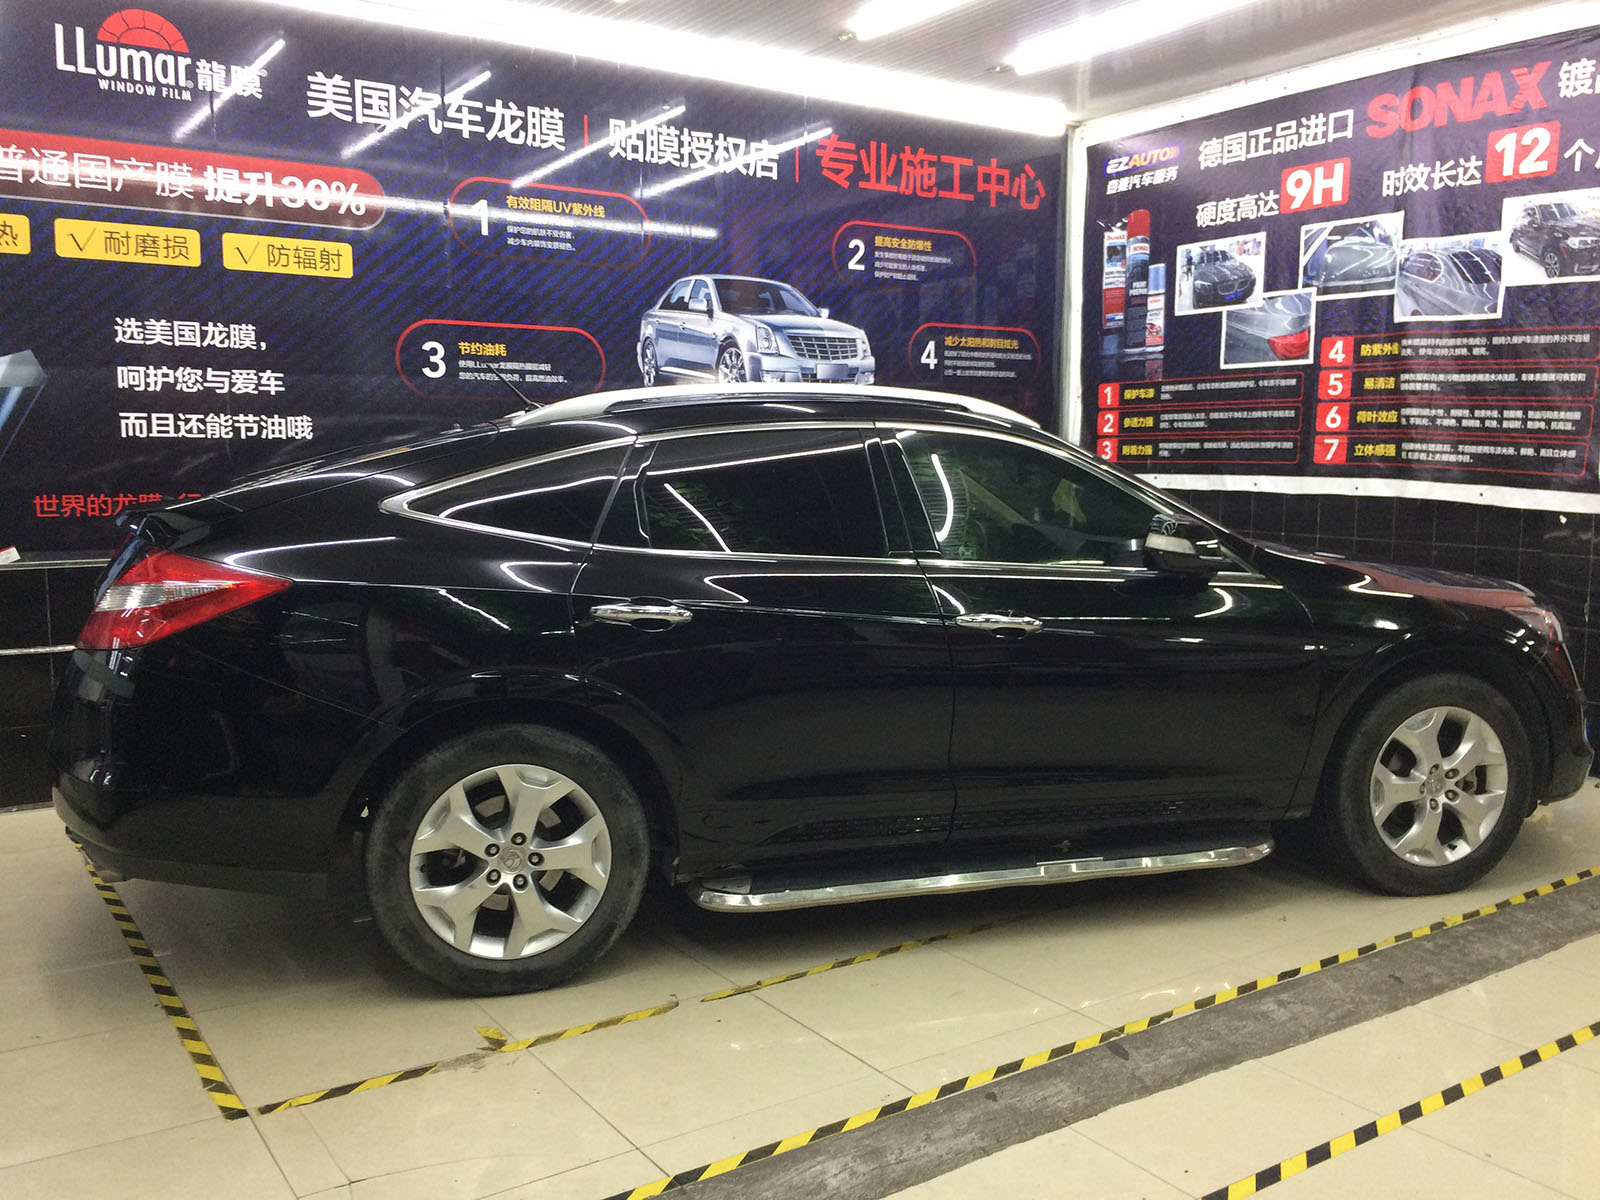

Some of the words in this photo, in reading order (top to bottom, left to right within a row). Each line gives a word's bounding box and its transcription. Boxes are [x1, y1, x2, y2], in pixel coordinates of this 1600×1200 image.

[55, 23, 192, 88] LLumar
[98, 78, 156, 96] WINDOW
[162, 87, 192, 101] FILM
[196, 58, 263, 99] 龍膜
[1558, 58, 1600, 99] 镀
[1365, 60, 1552, 139] SONAX
[306, 71, 566, 151] 美国汽车龙膜
[609, 119, 780, 182] 贴膜授权店
[815, 134, 1047, 210] 专业施工中心
[1198, 109, 1354, 170] 德国正品进口
[1382, 155, 1483, 197] 时效长达
[1494, 127, 1552, 177] 12
[1563, 139, 1600, 172] 个
[203, 165, 367, 216] 提升30%
[1196, 189, 1280, 228] 硬度高达
[1286, 163, 1344, 209] 9H
[471, 200, 489, 236] 1
[506, 195, 606, 218] 有效阻隔UV紫外线
[104, 230, 190, 260] 耐磨损
[267, 244, 342, 272] 防辐射
[848, 239, 865, 271] 2
[114, 317, 268, 351] 选美国龙膜，
[421, 341, 447, 378] 3
[458, 341, 507, 357] 节约油耗
[920, 341, 938, 370] 4
[1328, 340, 1346, 363] 4
[117, 366, 286, 395] 呵护您与爱车
[1327, 373, 1344, 396] 5
[1104, 386, 1112, 405] 1
[119, 412, 313, 440] 而且还能节油哦
[1103, 413, 1114, 433] 2
[1325, 406, 1342, 429] 6
[1356, 410, 1398, 424] 荷叶效应
[1101, 441, 1112, 459] 3
[1323, 438, 1340, 461] 7
[1353, 443, 1396, 457] 立体感强
